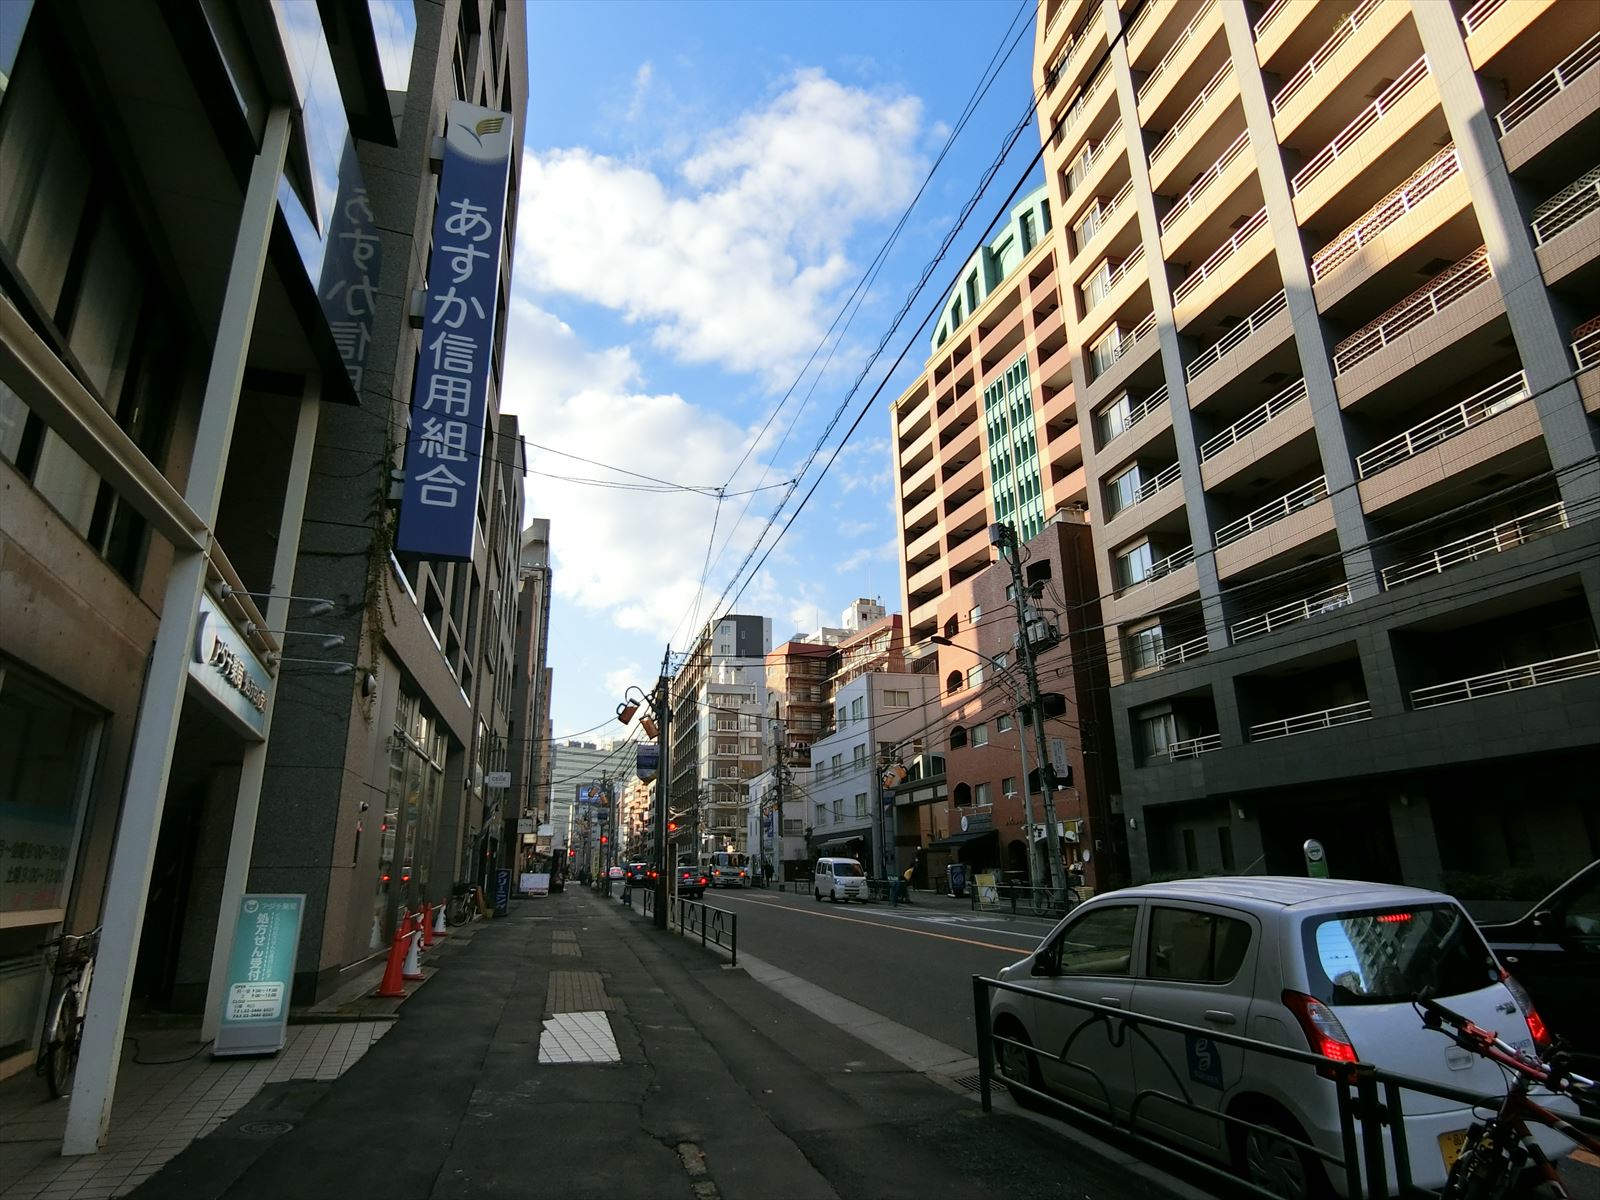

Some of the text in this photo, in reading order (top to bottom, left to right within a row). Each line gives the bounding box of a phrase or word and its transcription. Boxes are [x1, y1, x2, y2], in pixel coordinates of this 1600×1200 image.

[415, 197, 492, 509] あすか信用組合
[247, 912, 270, 981] 処方せん受付
